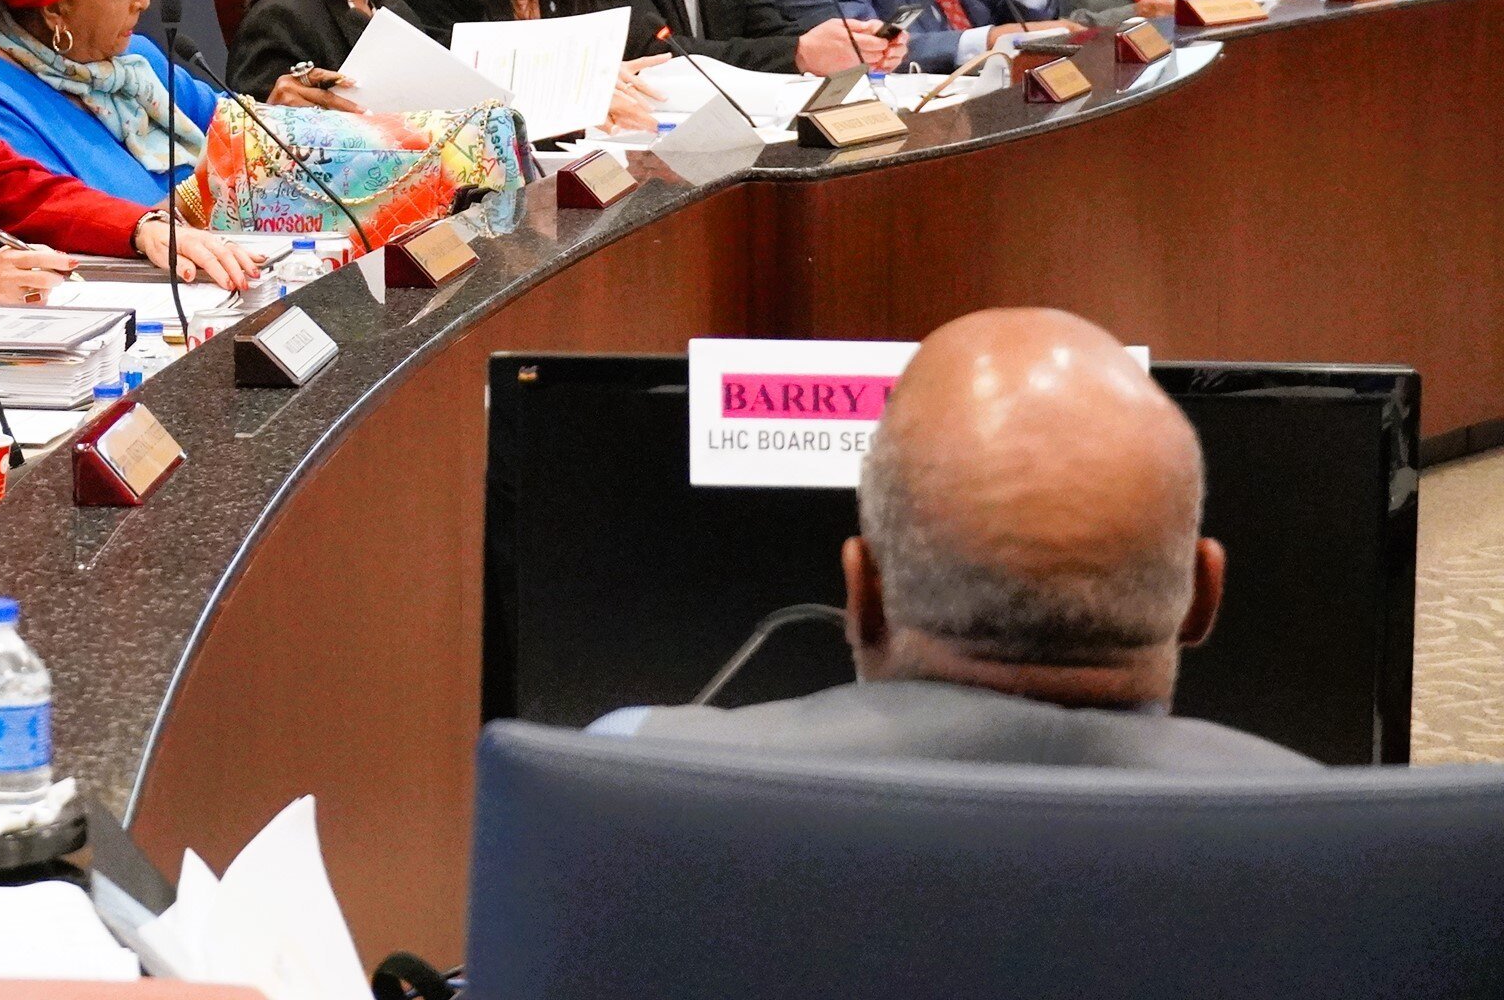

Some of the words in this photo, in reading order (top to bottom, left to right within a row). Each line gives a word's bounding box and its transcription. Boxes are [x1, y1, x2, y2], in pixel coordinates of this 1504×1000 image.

[723, 382, 867, 413] BARRY
[708, 429, 749, 450] LHC
[758, 430, 831, 451] BOARD
[840, 431, 874, 452] SE
